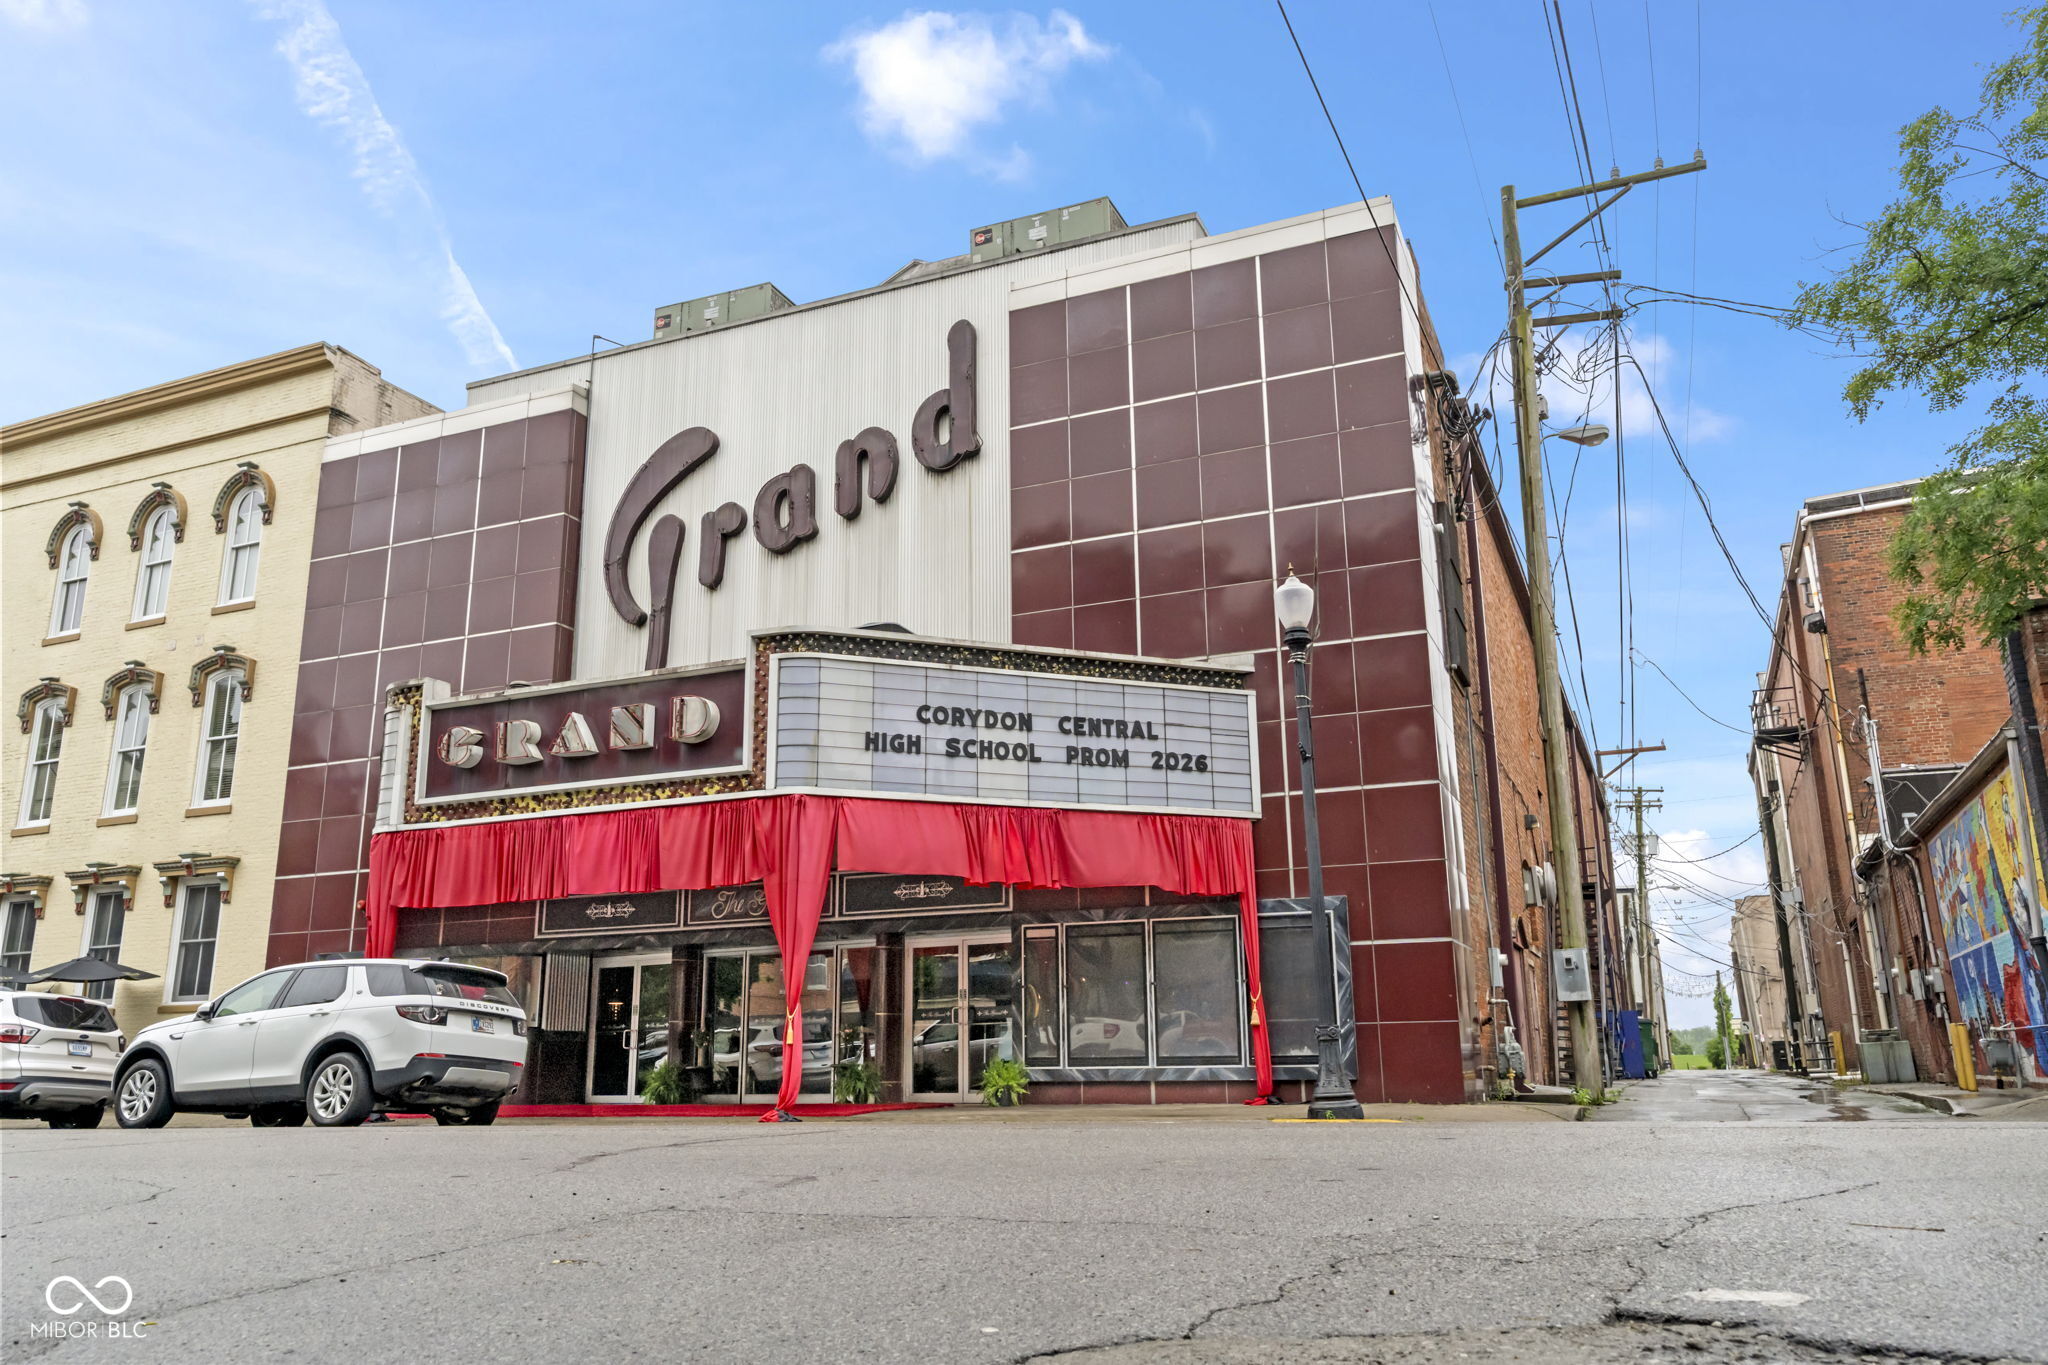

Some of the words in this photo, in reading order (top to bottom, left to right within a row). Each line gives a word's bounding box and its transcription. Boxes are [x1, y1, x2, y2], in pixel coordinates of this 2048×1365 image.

[604, 319, 982, 669] Grand
[437, 694, 720, 768] GRAND
[916, 704, 1033, 732] CORYDON
[1058, 715, 1159, 740] CENTRAL
[864, 731, 922, 755] HIGH
[945, 738, 1042, 763] SCHOOL
[1066, 744, 1130, 768] PROM
[1151, 750, 1209, 773] 2026
[711, 890, 744, 919] The
[459, 1001, 510, 1013] DISCOVERY
